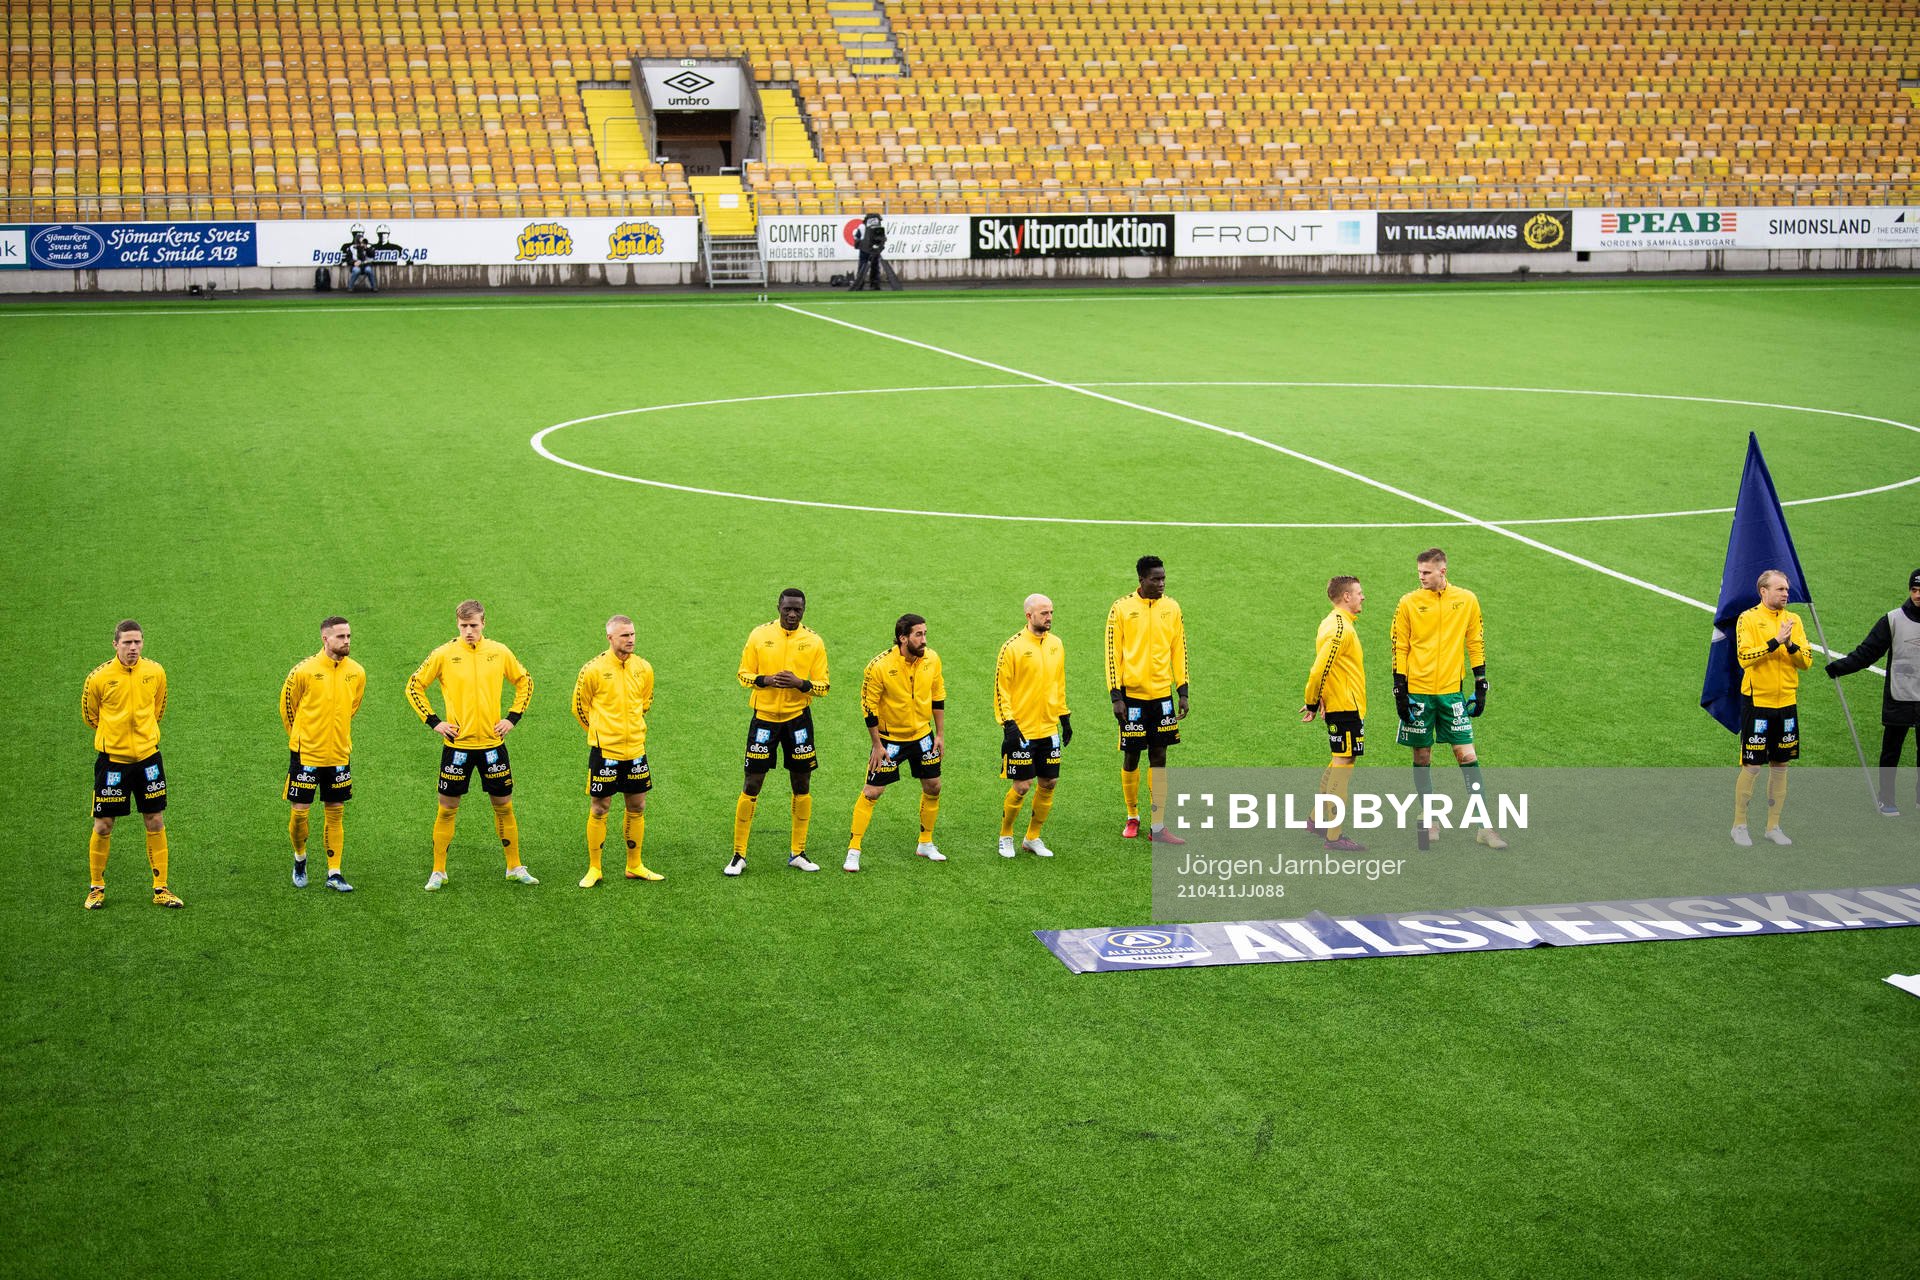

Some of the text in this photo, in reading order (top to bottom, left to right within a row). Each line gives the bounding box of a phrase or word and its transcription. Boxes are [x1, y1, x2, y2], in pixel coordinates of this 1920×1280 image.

[668, 96, 710, 106] umbro
[886, 221, 960, 235] Vi installerar
[1616, 212, 1721, 233] PEAB
[1769, 219, 1871, 234] SIMONSLAND
[44, 233, 91, 243] Sjömarkens
[107, 226, 251, 250] Sjömarkens Svets
[769, 224, 838, 243] COMFORT
[979, 217, 1167, 255] Skyltproduktion
[1192, 225, 1323, 242] FRONT
[1385, 225, 1400, 240] VI
[1404, 224, 1518, 240] TILLSAMMANS
[48, 242, 88, 251] Svets och
[515, 233, 574, 261] Landet
[606, 232, 665, 260] Landet
[887, 240, 957, 256] allt vi säljer
[1647, 238, 1736, 247] SAMHÄLLSBYGGARE
[47, 252, 90, 260] Smide AB
[120, 245, 238, 263] och Smide AB
[1401, 732, 1409, 741] 31
[1356, 742, 1363, 751] 17
[1008, 765, 1017, 775] 16
[289, 787, 299, 796] 21
[591, 783, 603, 792] 20
[96, 803, 102, 812] 6
[1222, 888, 1920, 961] ALLSVENSKAN
[1107, 946, 1197, 956] ALLSVENSKAN
